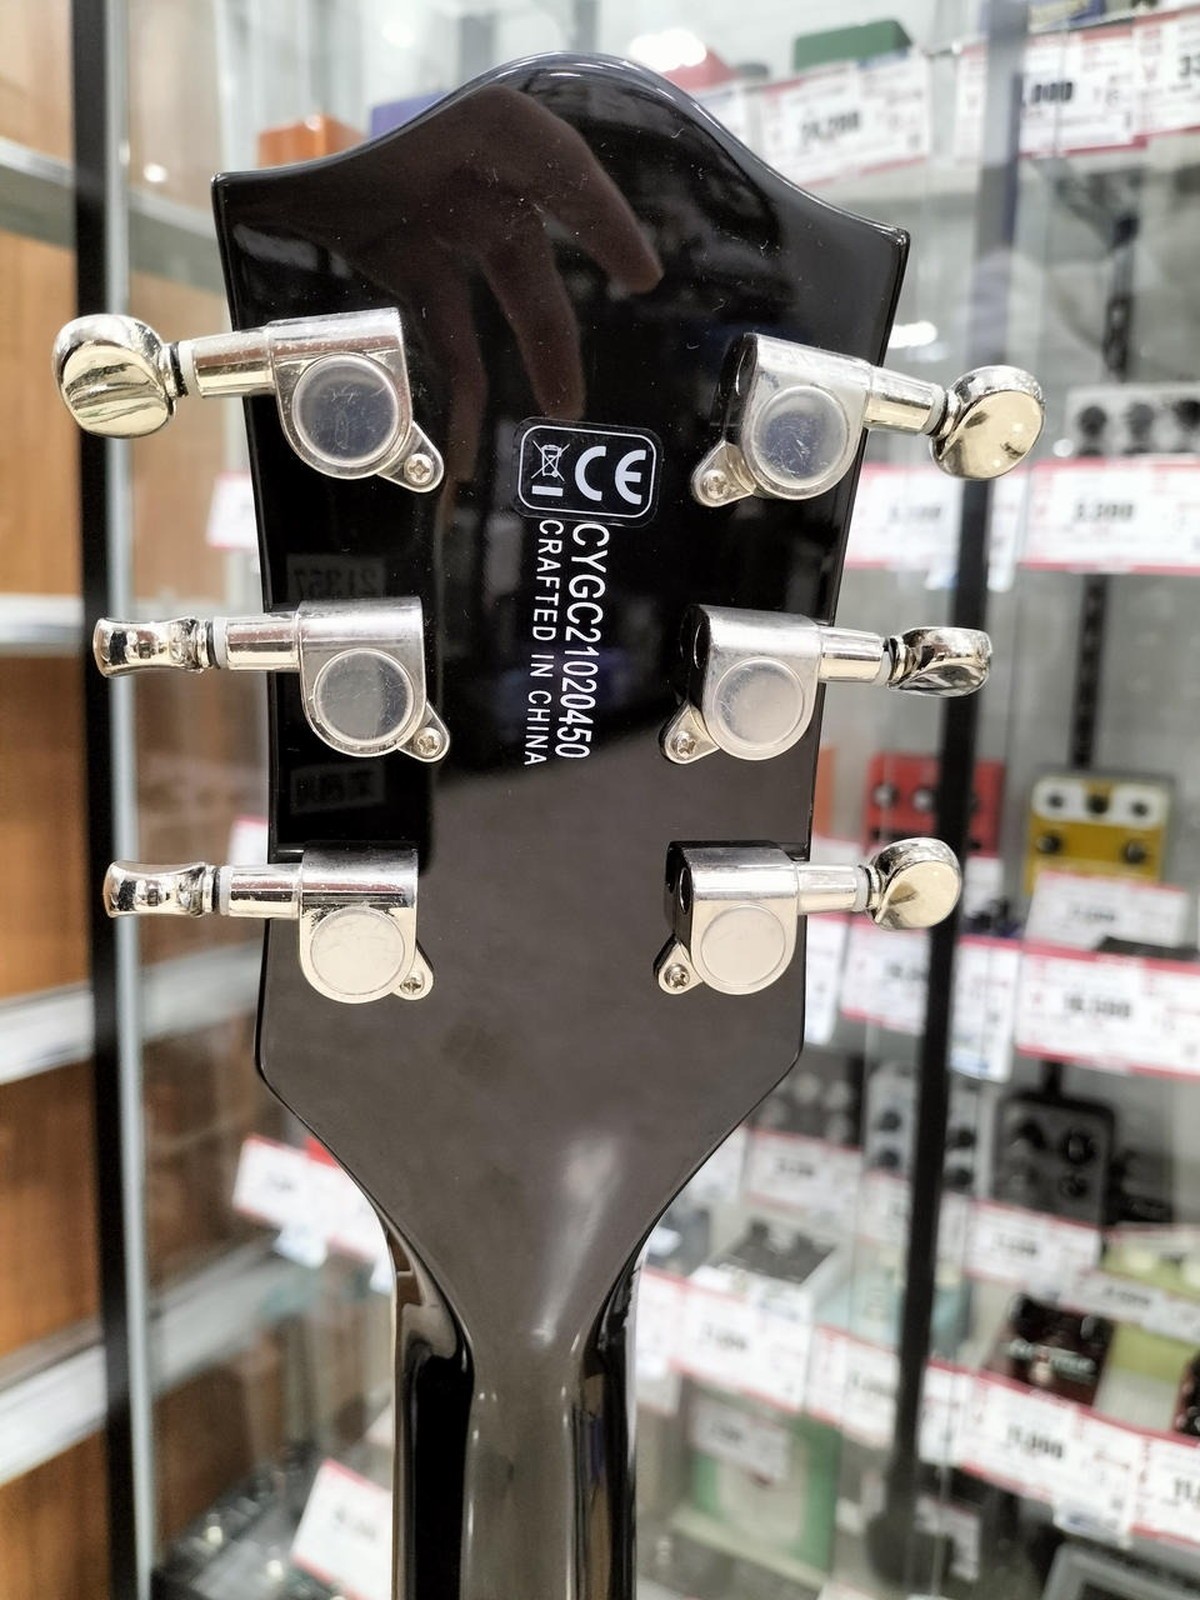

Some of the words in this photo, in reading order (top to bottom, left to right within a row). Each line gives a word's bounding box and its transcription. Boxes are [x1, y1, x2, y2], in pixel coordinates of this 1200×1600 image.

[574, 445, 647, 505] CE
[532, 519, 564, 641] CRAFTED
[529, 654, 554, 678] IN
[554, 522, 610, 759] CYGC21020450
[523, 690, 552, 766] CHINA
